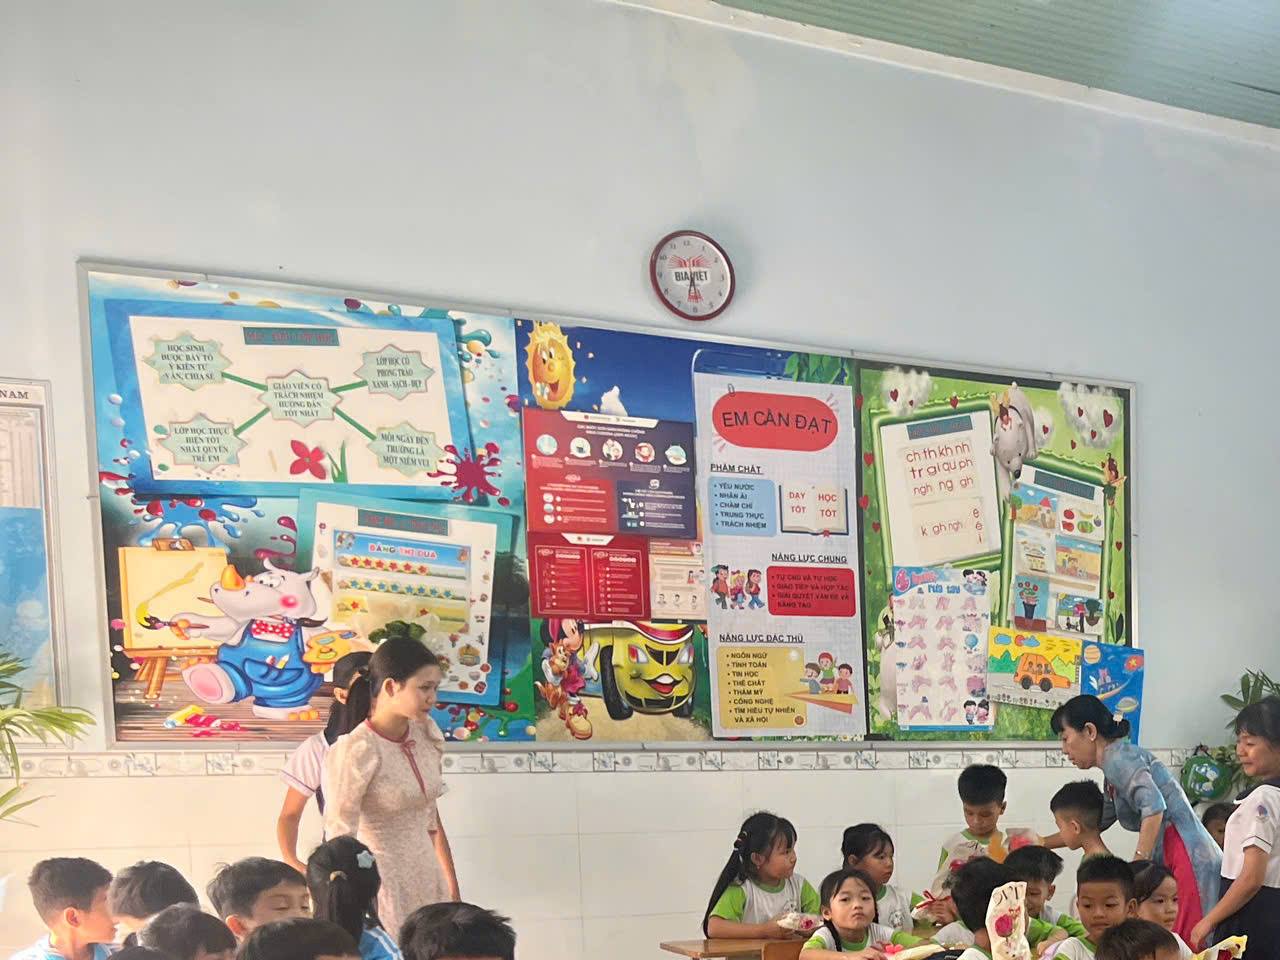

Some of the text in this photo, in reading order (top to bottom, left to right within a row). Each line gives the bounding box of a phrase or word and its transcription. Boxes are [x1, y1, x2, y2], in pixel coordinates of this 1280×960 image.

[674, 271, 690, 281] BIA
[0, 390, 29, 399] NAM
[722, 408, 832, 434] EM CẦN ĐẠT
[906, 442, 970, 462] ch th kh nh
[910, 466, 923, 480] tr
[942, 460, 957, 472] qu
[913, 476, 974, 496] ngh ng gh
[818, 494, 837, 503] HỌC
[720, 510, 745, 518] TRUNG
[921, 521, 963, 536] k gh ngh
[818, 555, 848, 564] CHUNG
